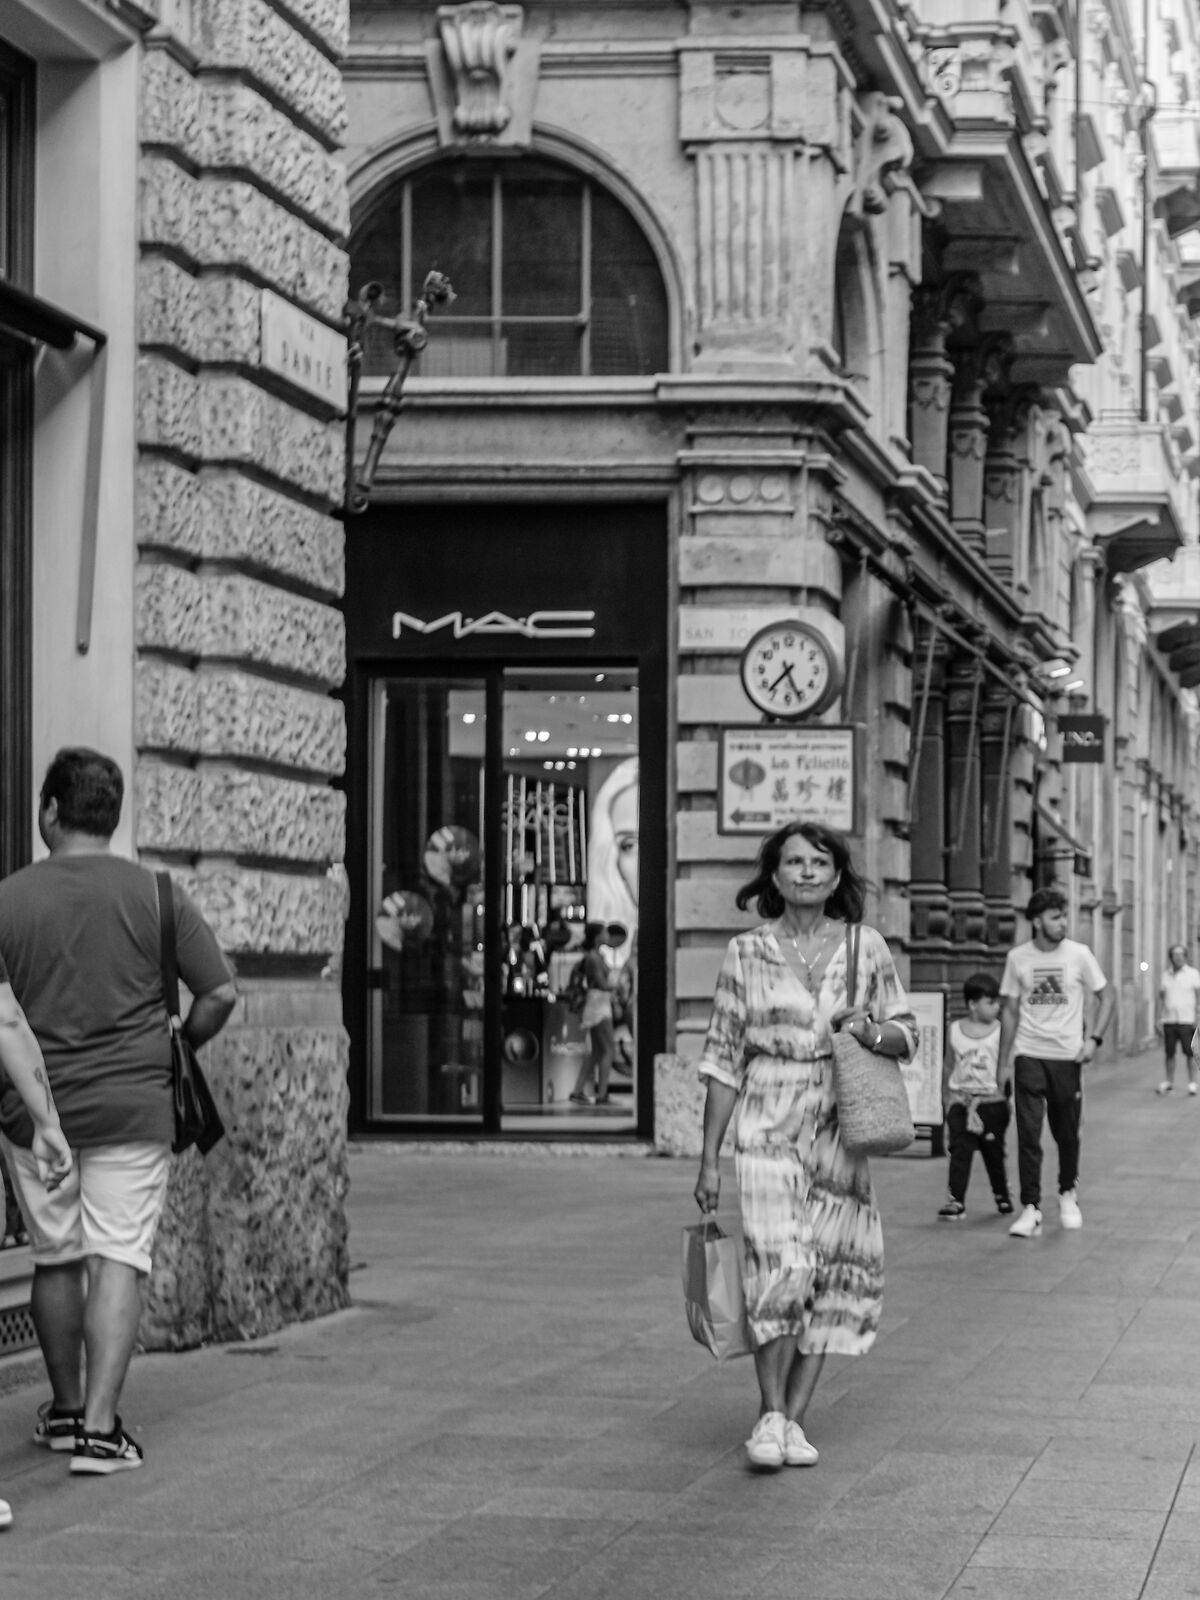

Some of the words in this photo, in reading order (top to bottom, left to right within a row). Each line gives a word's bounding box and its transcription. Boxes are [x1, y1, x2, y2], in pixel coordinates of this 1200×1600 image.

[281, 339, 333, 391] DANTE
[686, 627, 715, 640] SAN
[784, 635, 795, 647] 12
[762, 650, 773, 661] 10
